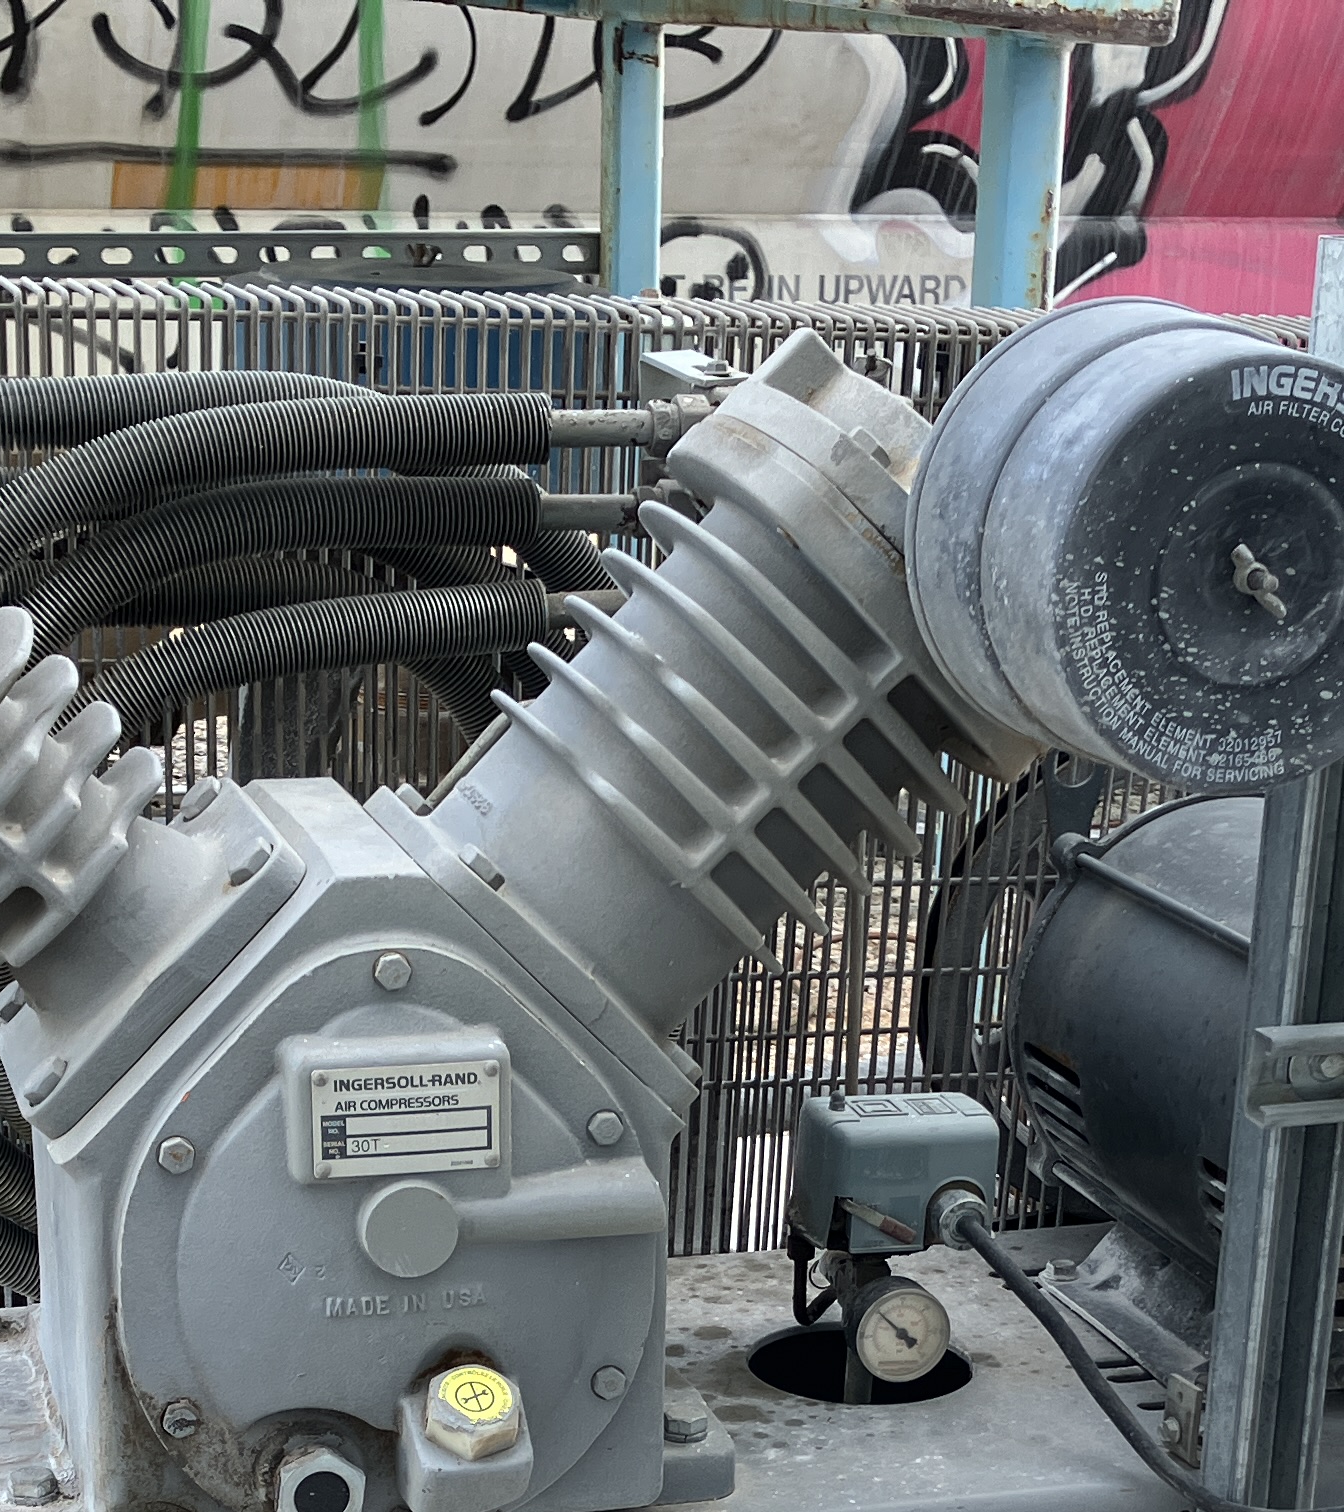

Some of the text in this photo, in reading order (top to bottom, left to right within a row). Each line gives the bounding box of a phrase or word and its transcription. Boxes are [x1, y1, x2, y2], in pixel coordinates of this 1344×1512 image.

[1247, 401, 1273, 417] AIR
[1278, 401, 1330, 427] FILTER
[1084, 626, 1145, 732] REPLACEMENT
[1095, 610, 1153, 714] REPLACEMENT
[1151, 713, 1216, 748] ELEMENT
[1068, 631, 1285, 783] INSTRUCTION MANUAL FOR SERVICING
[333, 1072, 478, 1093] INGERSOLL-RAND
[335, 1094, 459, 1113] AIR COMPRESSORS
[351, 1138, 381, 1153] 30T
[325, 1283, 488, 1318] MADE IN USA
